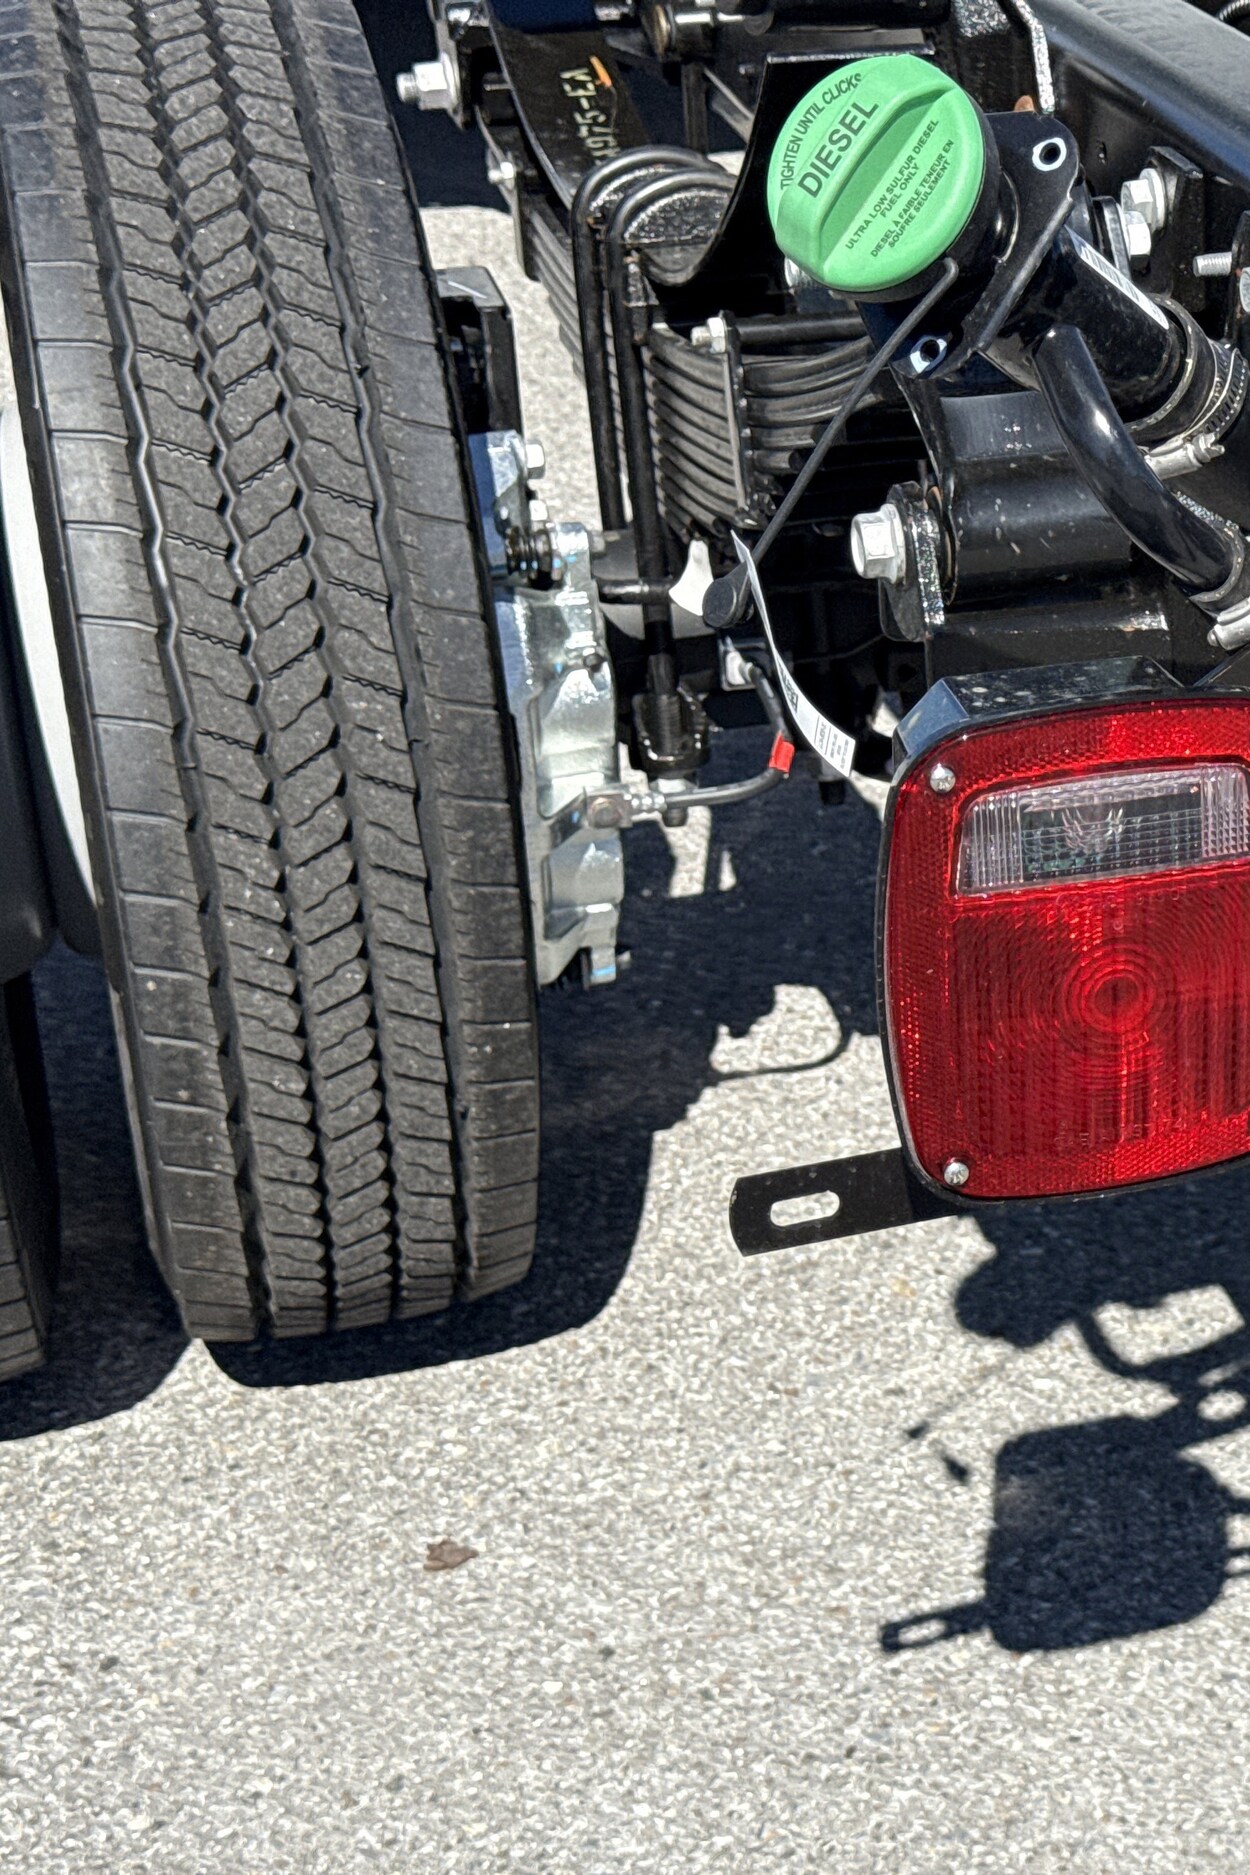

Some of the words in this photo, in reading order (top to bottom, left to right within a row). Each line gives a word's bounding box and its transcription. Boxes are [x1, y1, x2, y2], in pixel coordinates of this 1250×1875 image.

[780, 134, 804, 190] TIGHTEN
[794, 102, 826, 135] UNTIL
[821, 72, 862, 105] CLICKS
[797, 101, 880, 198] DIESEL
[845, 219, 873, 250] ULTRA
[868, 194, 889, 219] LOW
[886, 154, 916, 195] SULFUR
[912, 119, 940, 155] DIESEL
[870, 228, 897, 258] DIESEL
[898, 188, 922, 220] FAIBLE
[919, 153, 946, 188] TENEUR
[942, 139, 955, 154] EN
[880, 193, 903, 218] FUEL
[899, 162, 920, 191] ONLY
[888, 213, 917, 248] SOUFRE
[913, 158, 951, 213] SEULEMENT
